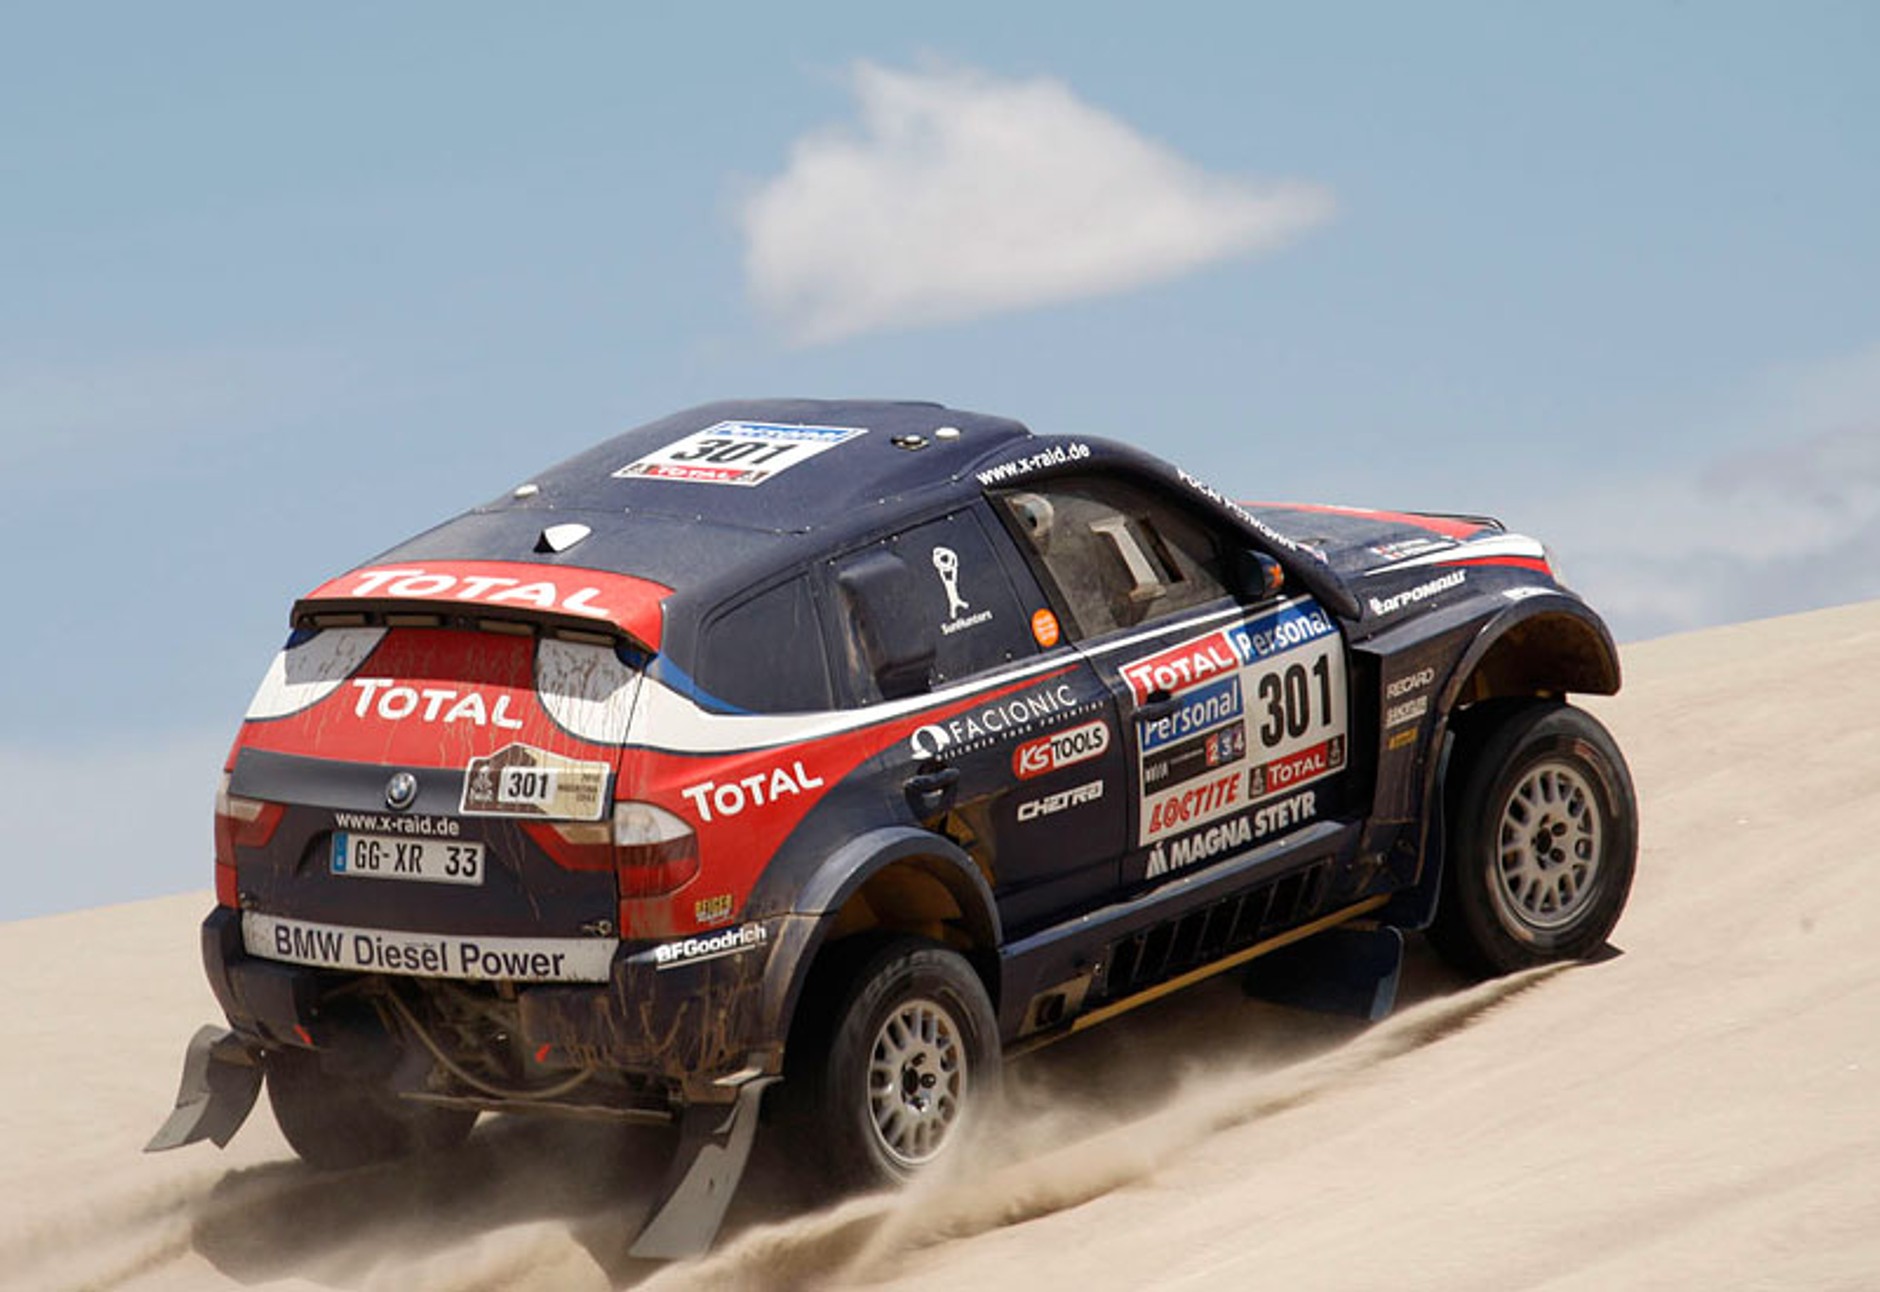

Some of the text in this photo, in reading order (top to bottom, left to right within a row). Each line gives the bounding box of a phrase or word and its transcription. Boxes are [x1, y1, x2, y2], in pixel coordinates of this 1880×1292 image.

[669, 438, 800, 465] 301
[976, 441, 1091, 486] www.x-raid.de
[351, 568, 610, 616] TOTAL
[1130, 607, 1333, 693] TOTAL Personal
[352, 677, 524, 731] TOTAL
[949, 685, 1078, 745] FACIONIC
[1259, 652, 1332, 748] 301
[508, 772, 549, 799] 301
[682, 761, 824, 822] TOTAL
[1270, 753, 1326, 786] TOTAL
[335, 812, 460, 836] www.x-raid.de
[1147, 771, 1242, 834] LOCTITE
[1170, 790, 1317, 869] MAGNA STEYR
[445, 846, 478, 877] 33
[275, 925, 566, 977] BMW Diesel Power
[655, 923, 767, 963] BFGoodrich
